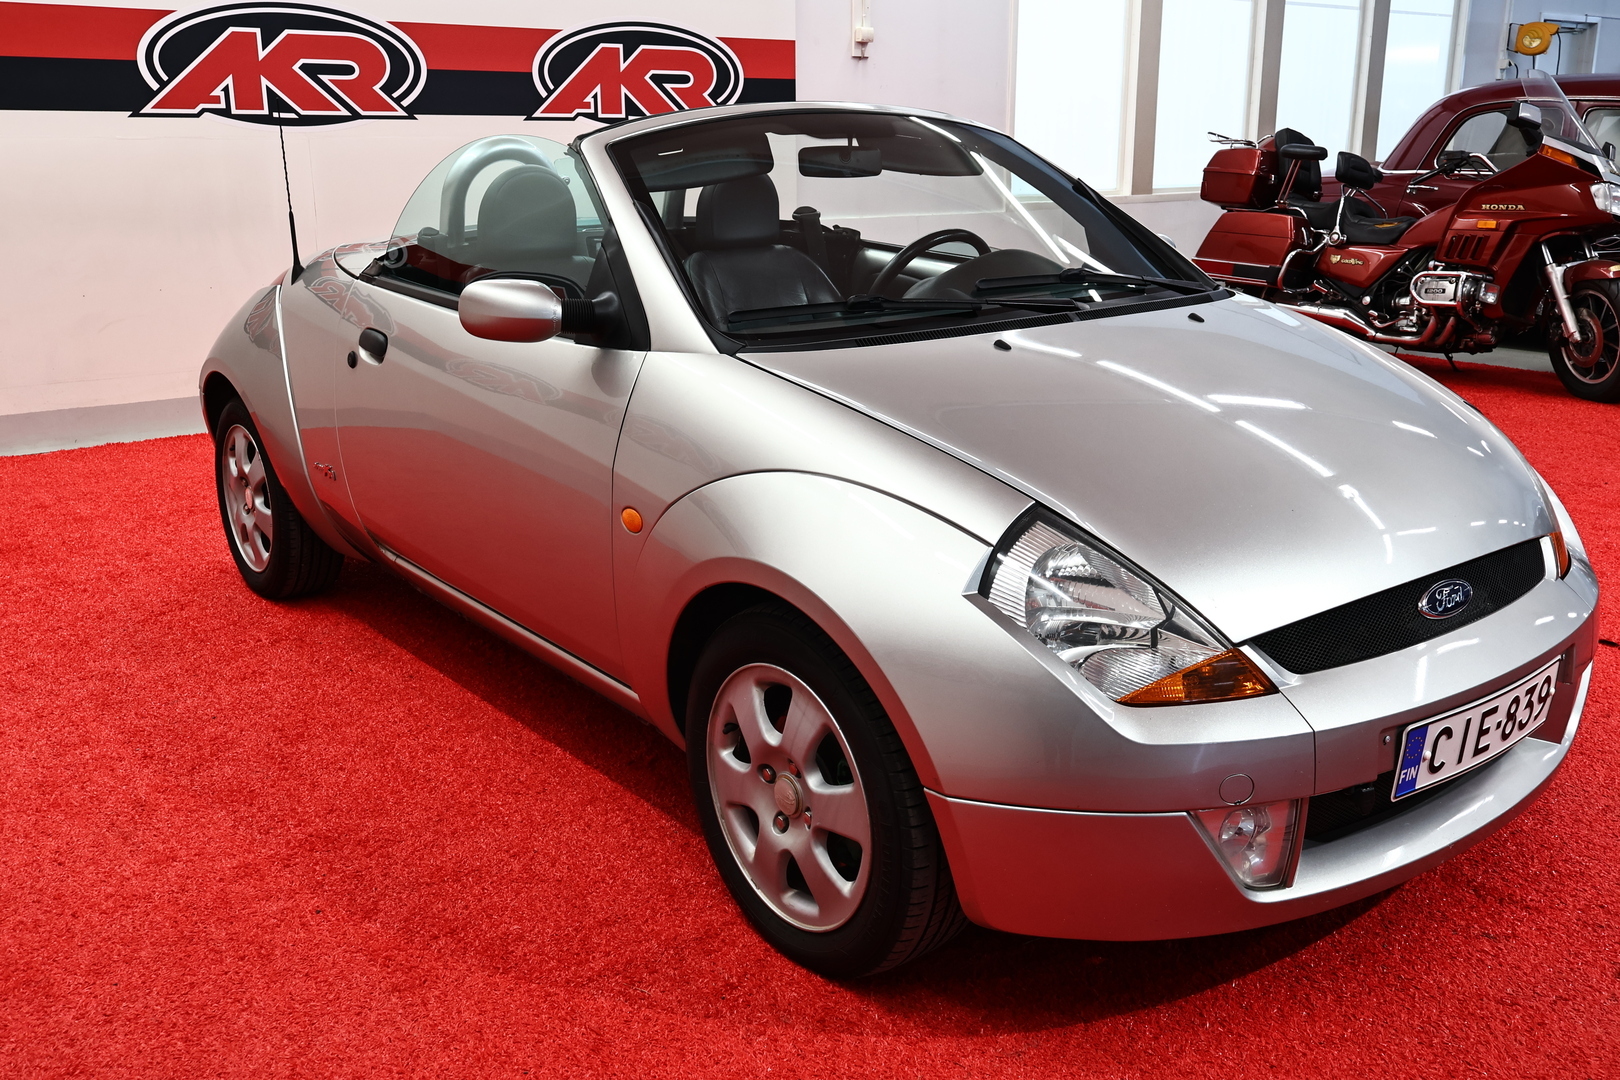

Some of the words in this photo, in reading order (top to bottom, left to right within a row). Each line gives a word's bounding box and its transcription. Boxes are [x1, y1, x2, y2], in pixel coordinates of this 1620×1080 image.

[138, 26, 410, 116] AKR
[530, 43, 718, 118] AKR
[1435, 585, 1464, 611] Ford
[1428, 675, 1552, 774] CIE-839
[1399, 765, 1419, 785] FIN
